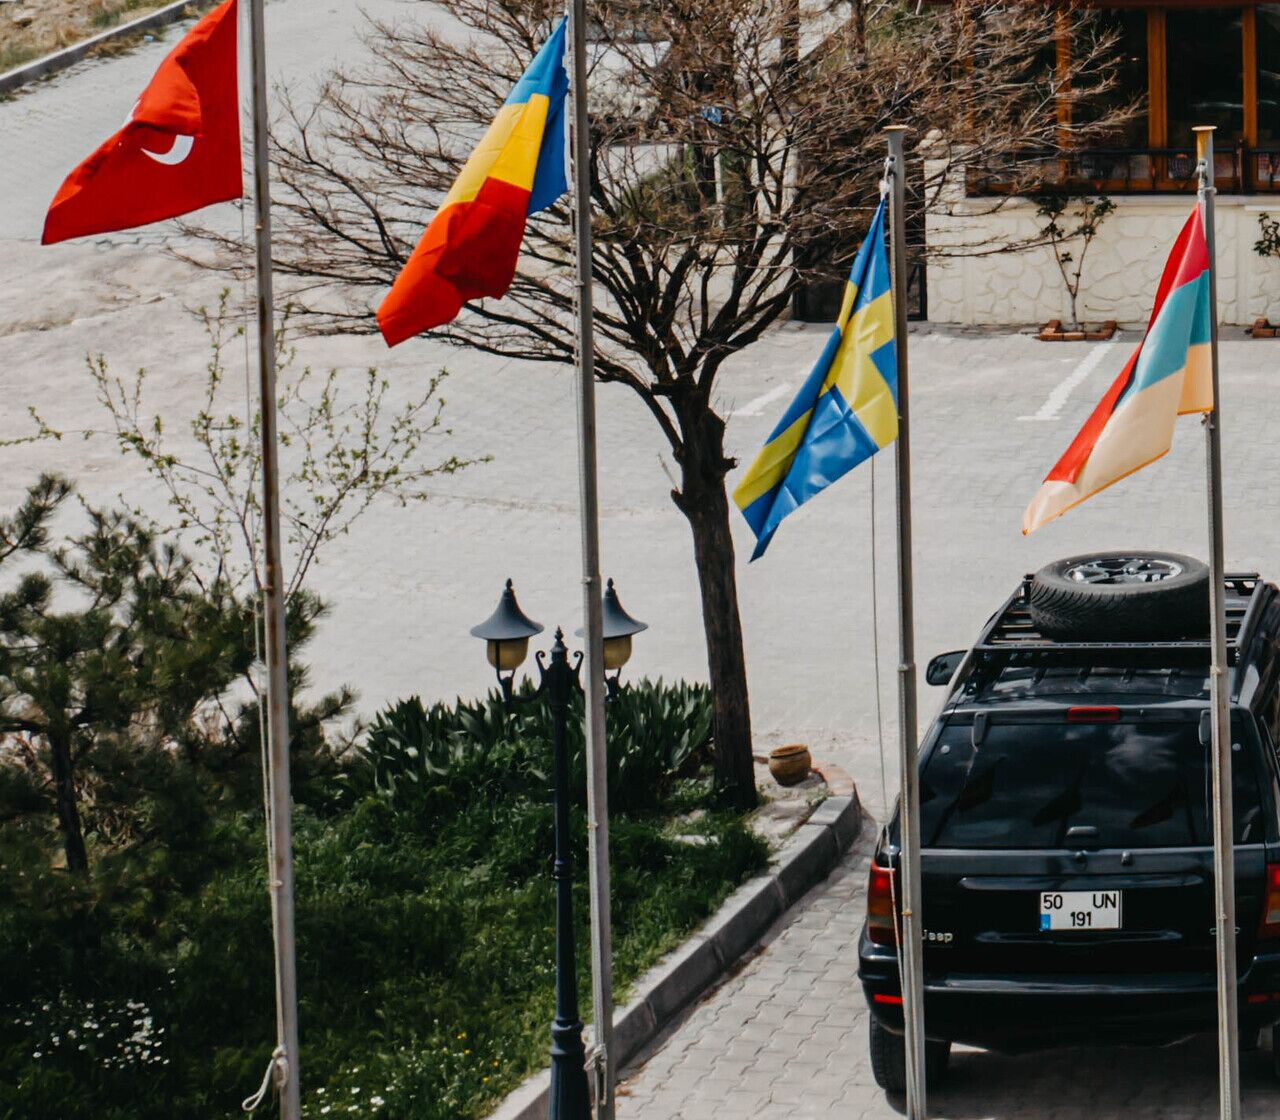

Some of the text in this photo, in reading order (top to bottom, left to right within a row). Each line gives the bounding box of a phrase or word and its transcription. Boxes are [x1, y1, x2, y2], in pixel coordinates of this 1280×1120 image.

[1043, 893, 1117, 910] 50 UN
[1070, 911, 1092, 927] 191
